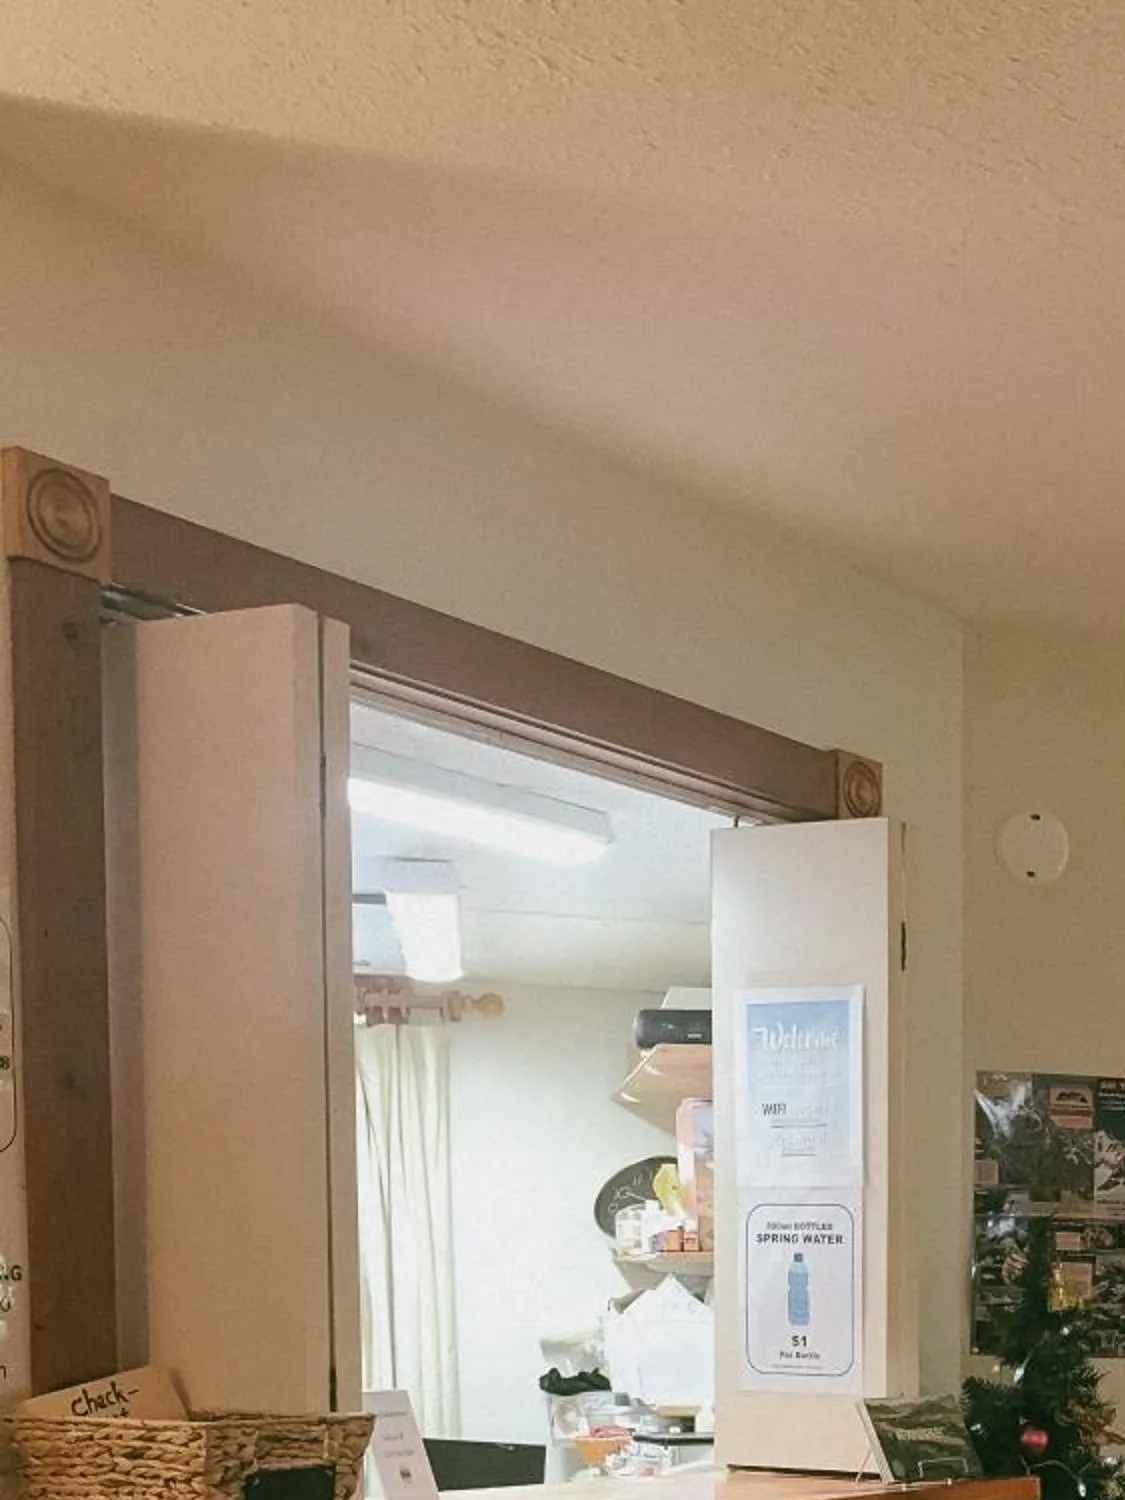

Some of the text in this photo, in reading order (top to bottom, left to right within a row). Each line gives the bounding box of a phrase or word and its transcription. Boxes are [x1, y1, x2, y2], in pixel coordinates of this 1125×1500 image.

[794, 1222, 833, 1231] BOTTLES
[756, 1233, 843, 1245] SPRING WATER
